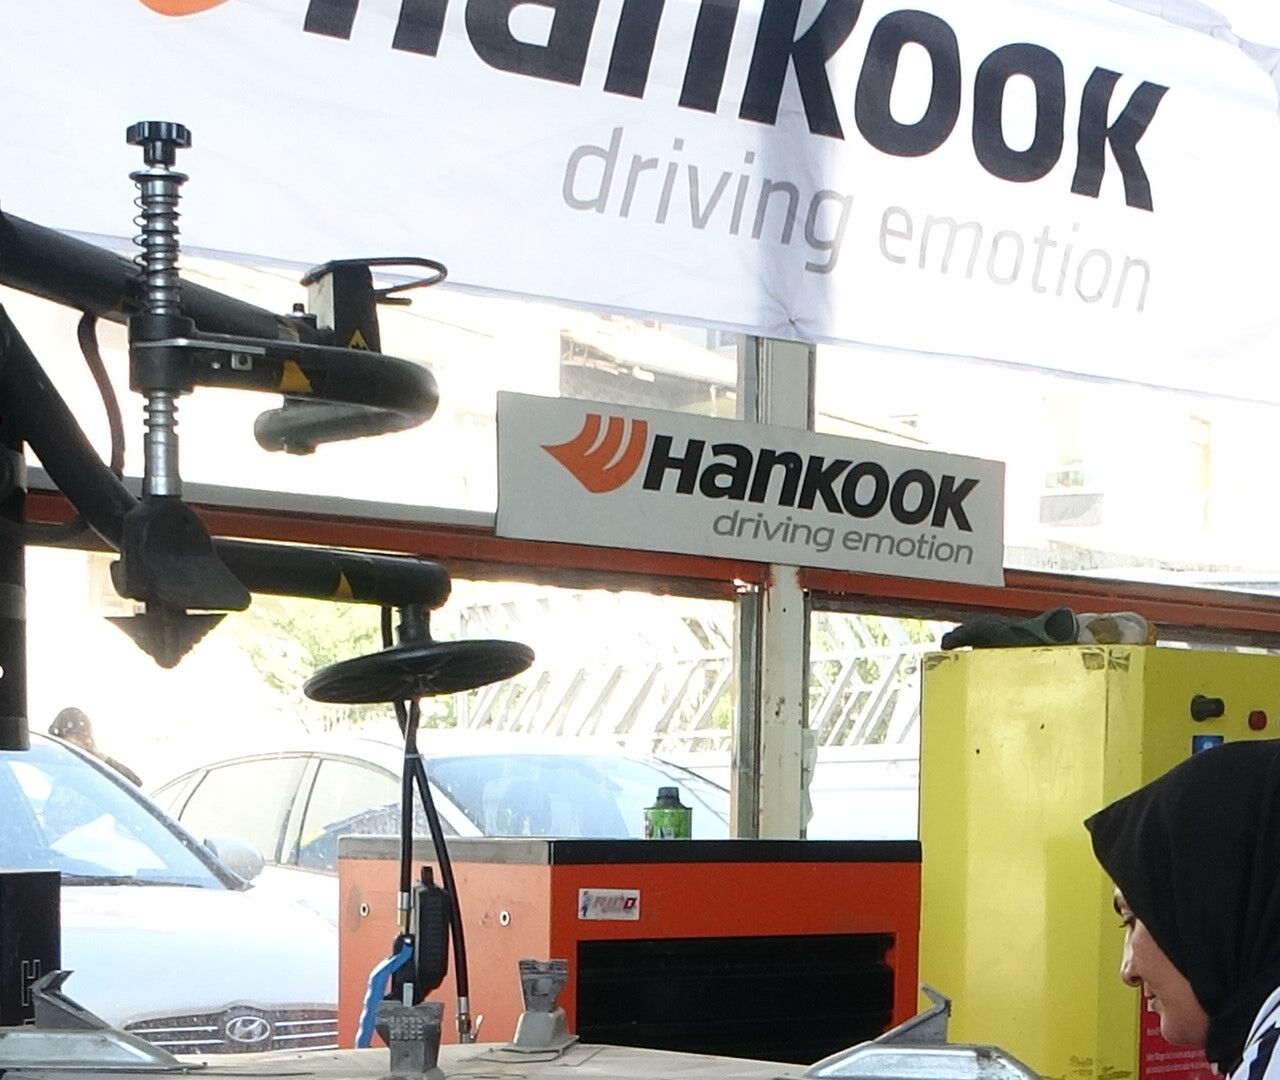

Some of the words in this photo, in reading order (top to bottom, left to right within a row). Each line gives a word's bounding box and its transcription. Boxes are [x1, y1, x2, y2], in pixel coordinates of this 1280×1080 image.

[561, 126, 853, 275] driving
[878, 204, 1152, 313] emotion
[713, 509, 834, 553] driving
[842, 530, 973, 566] emotion
